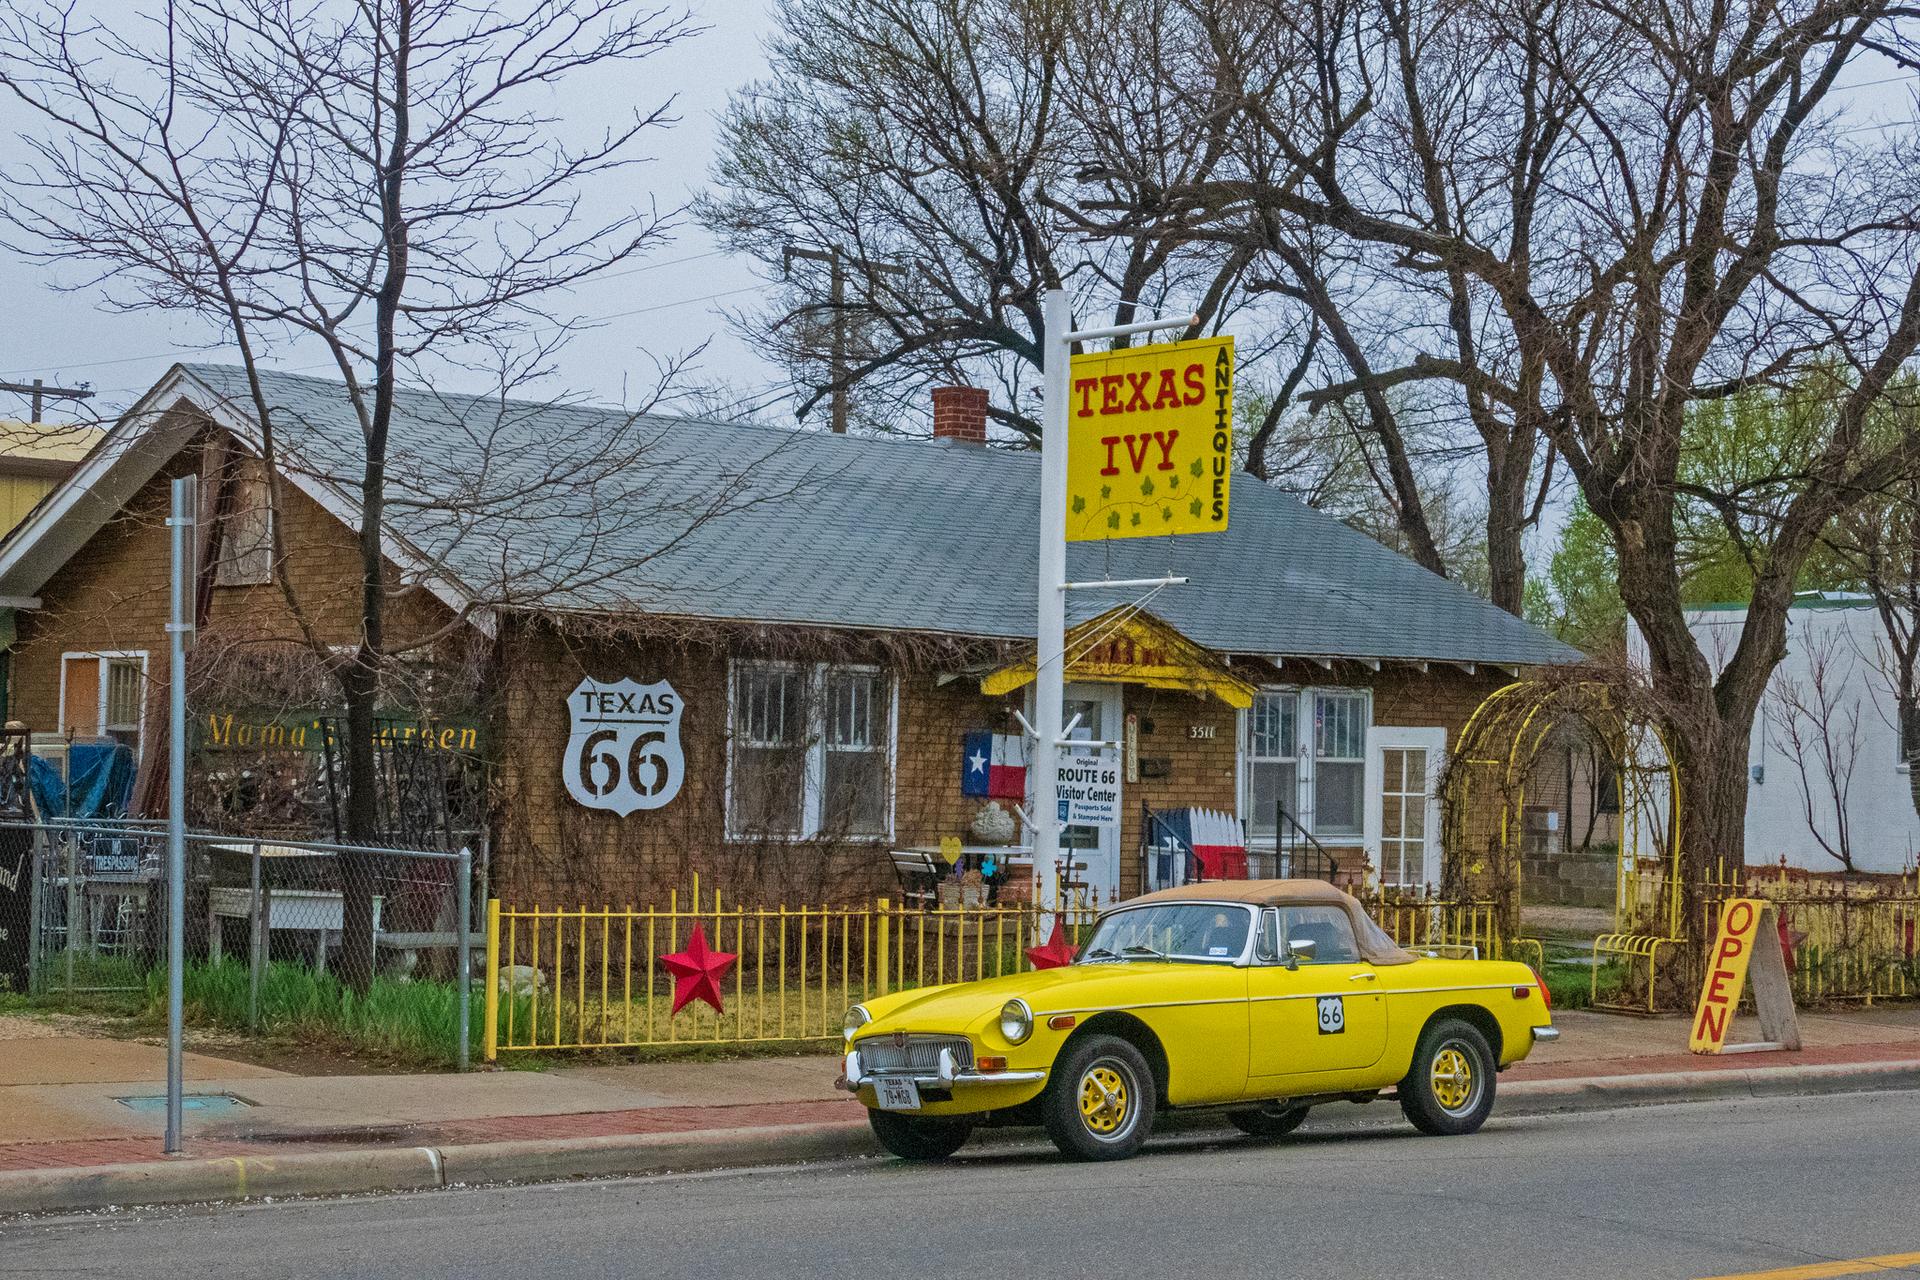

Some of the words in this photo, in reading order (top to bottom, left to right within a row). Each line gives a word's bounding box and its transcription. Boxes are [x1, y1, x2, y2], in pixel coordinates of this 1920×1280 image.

[1075, 363, 1206, 418] TEXAS
[1211, 346, 1230, 522] ANTIQUES
[1100, 429, 1179, 476] IVY
[580, 691, 674, 715] TEXAS
[371, 717, 478, 750] arden
[1190, 726, 1215, 739] 3511
[580, 730, 668, 797] 66
[1076, 758, 1099, 767] Original
[1058, 768, 1098, 783] ROUTE
[1101, 770, 1115, 785] 66
[1056, 785, 1085, 801] Visitor
[1087, 786, 1116, 802] Center
[1074, 803, 1099, 811] Passports
[1100, 804, 1112, 812] Sold
[1077, 813, 1100, 821] Stamped
[1696, 901, 1754, 1043] OPEN
[1321, 1005, 1342, 1025] 66
